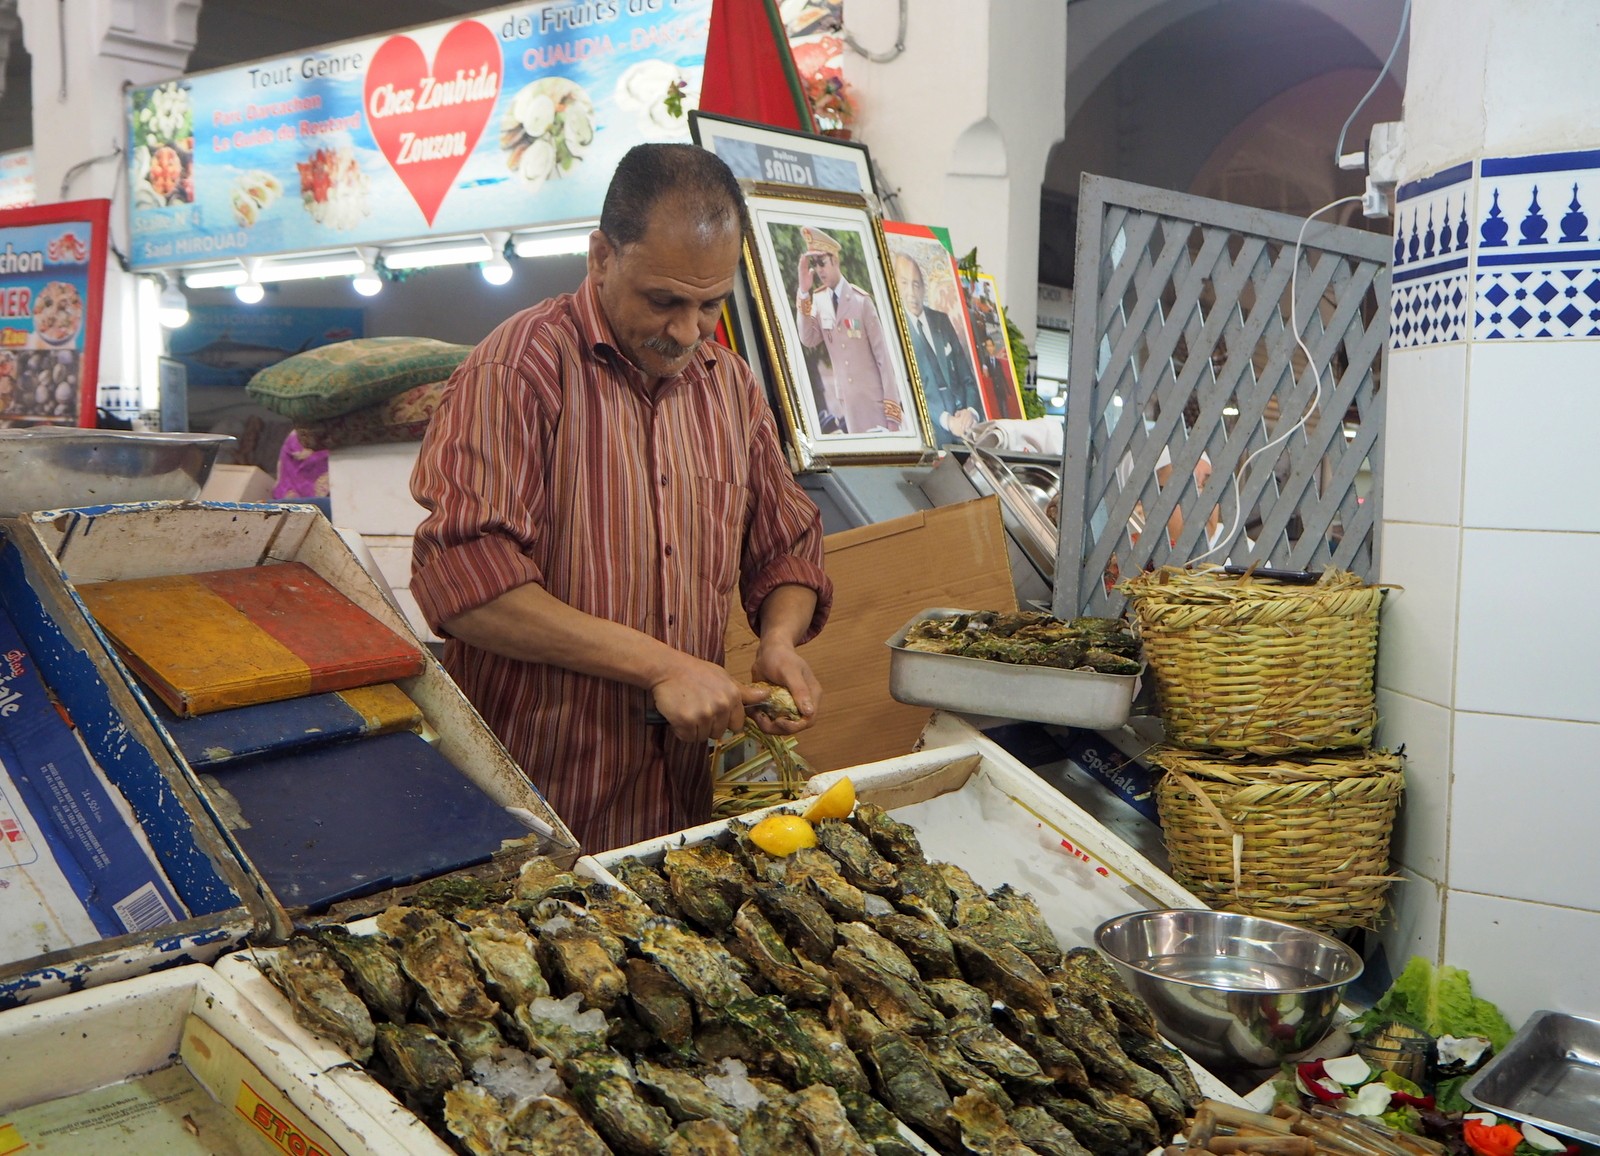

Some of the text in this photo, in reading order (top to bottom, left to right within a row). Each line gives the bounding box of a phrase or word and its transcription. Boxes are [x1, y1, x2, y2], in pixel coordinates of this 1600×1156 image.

[502, 14, 530, 39] de
[541, 0, 618, 32] Fruits
[248, 53, 363, 88] Tout Genre
[524, 35, 614, 70] OUALIDIA
[369, 61, 497, 118] Chez Zoubida
[213, 111, 361, 153] Le Guide du Routard
[396, 131, 467, 165] Zouzou
[765, 158, 814, 187] SAIDI
[1081, 748, 1136, 795] Spéciale
